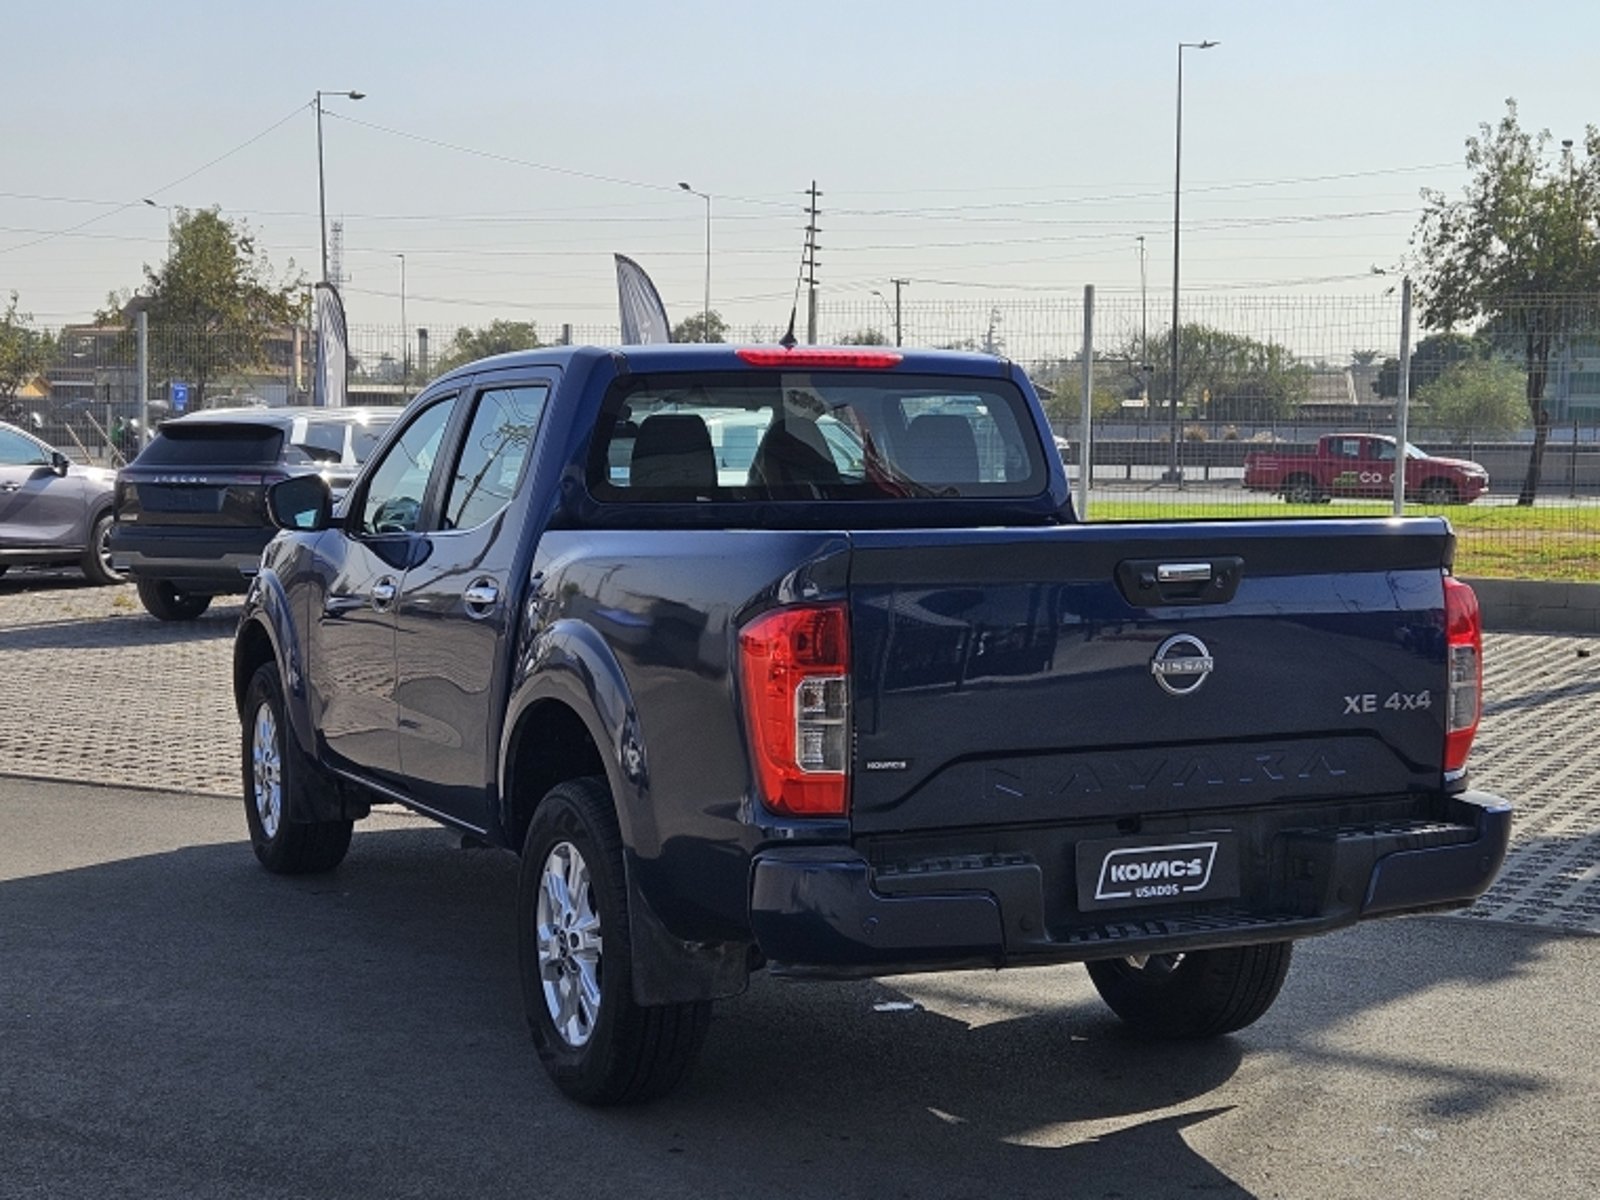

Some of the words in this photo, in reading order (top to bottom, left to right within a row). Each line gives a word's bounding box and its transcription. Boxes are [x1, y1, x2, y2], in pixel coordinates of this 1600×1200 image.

[1152, 661, 1212, 673] NISSAN
[1343, 694, 1377, 714] XE
[1383, 689, 1432, 711] 4x4
[866, 761, 906, 769] KOVACS
[982, 747, 1347, 799] NAVARA
[1110, 858, 1203, 882] KOVACS
[1135, 884, 1180, 898] USADOS
